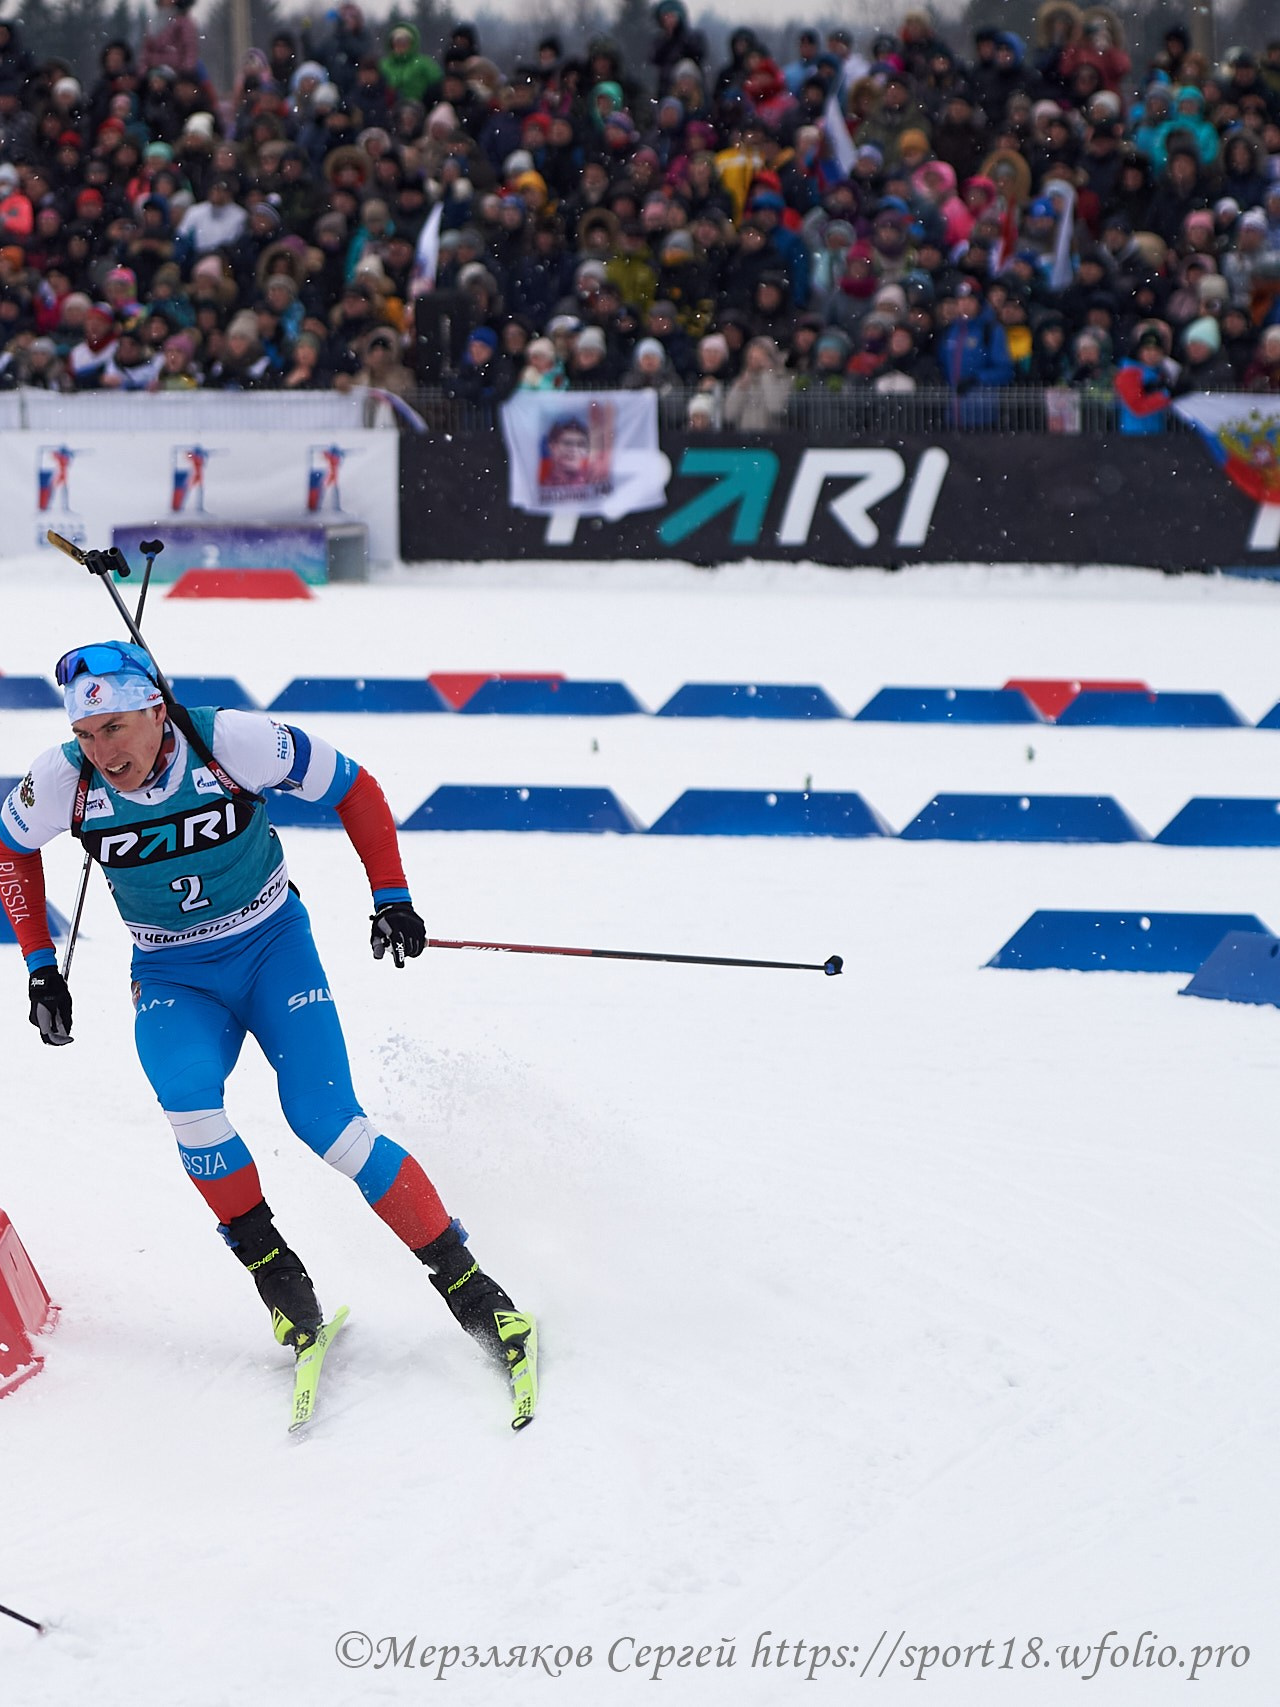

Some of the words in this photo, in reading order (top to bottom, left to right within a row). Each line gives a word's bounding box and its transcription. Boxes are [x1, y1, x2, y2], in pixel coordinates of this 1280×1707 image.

[7, 798, 30, 834] GAZPROM
[100, 803, 236, 863] PARI
[169, 874, 212, 914] 2
[180, 1149, 227, 1176] SSIA
[247, 1248, 280, 1272] SCHER
[447, 1262, 480, 1295] FISCHE
